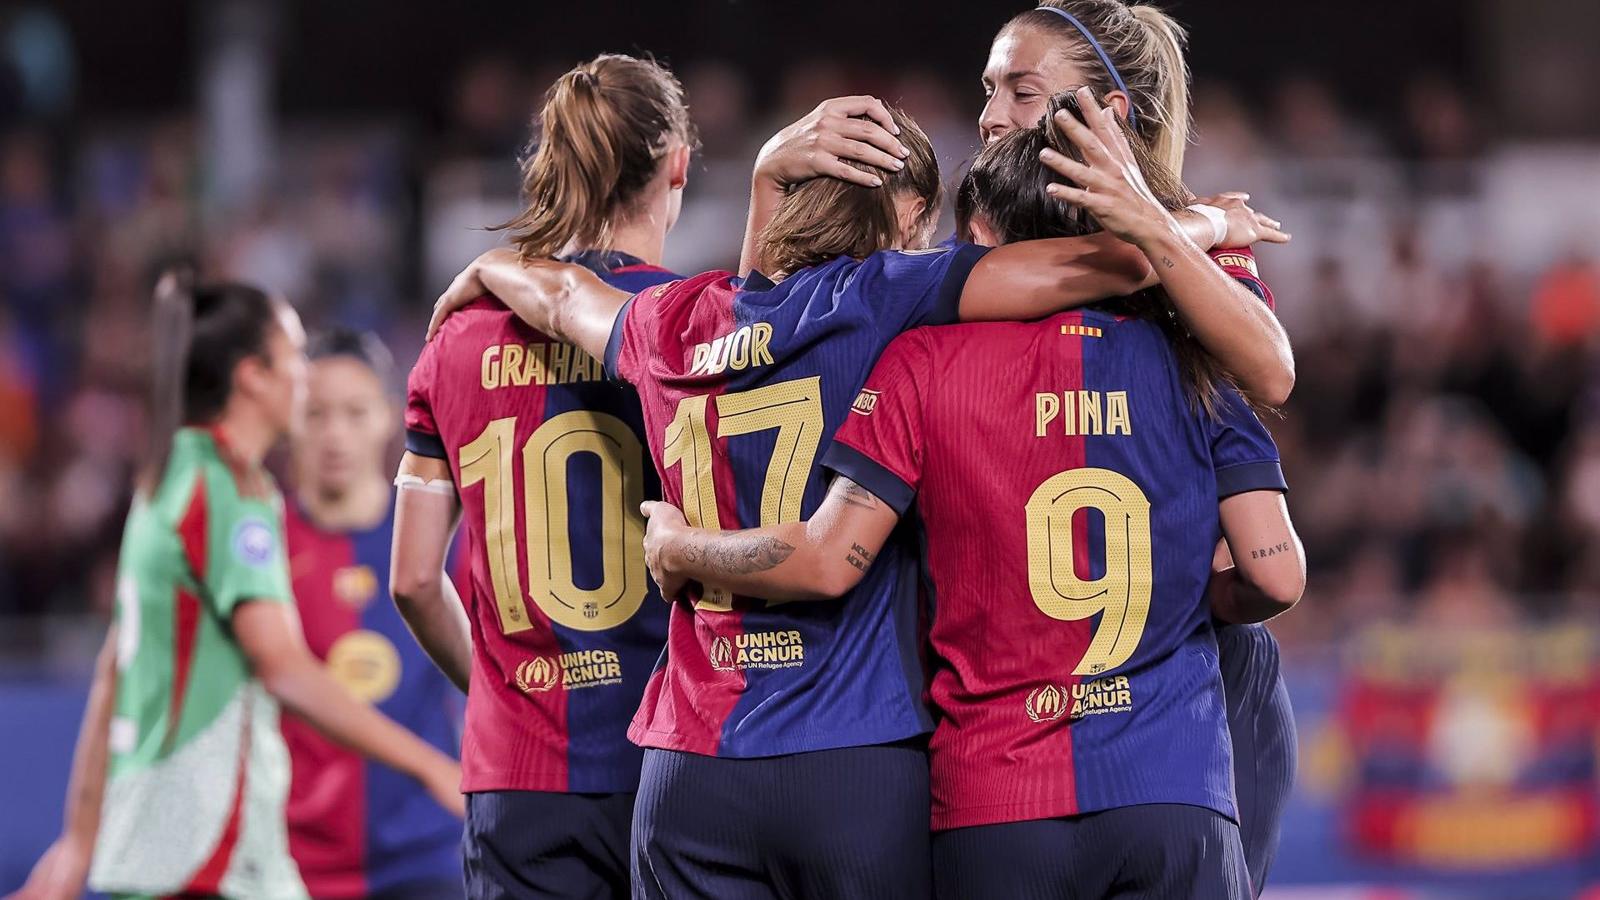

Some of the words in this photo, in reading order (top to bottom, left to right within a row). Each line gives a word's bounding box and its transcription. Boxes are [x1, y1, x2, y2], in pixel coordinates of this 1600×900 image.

[1035, 389, 1132, 437] PINA
[664, 377, 824, 611] 17
[459, 411, 649, 635] 10
[1251, 541, 1290, 559] BRAVE
[1025, 467, 1152, 676] 9
[735, 630, 803, 649] UNHCR
[558, 649, 619, 669] UNHCR
[736, 645, 804, 664] ACNUR
[561, 663, 622, 685] ACNUR
[1071, 691, 1131, 713] ACNUR
